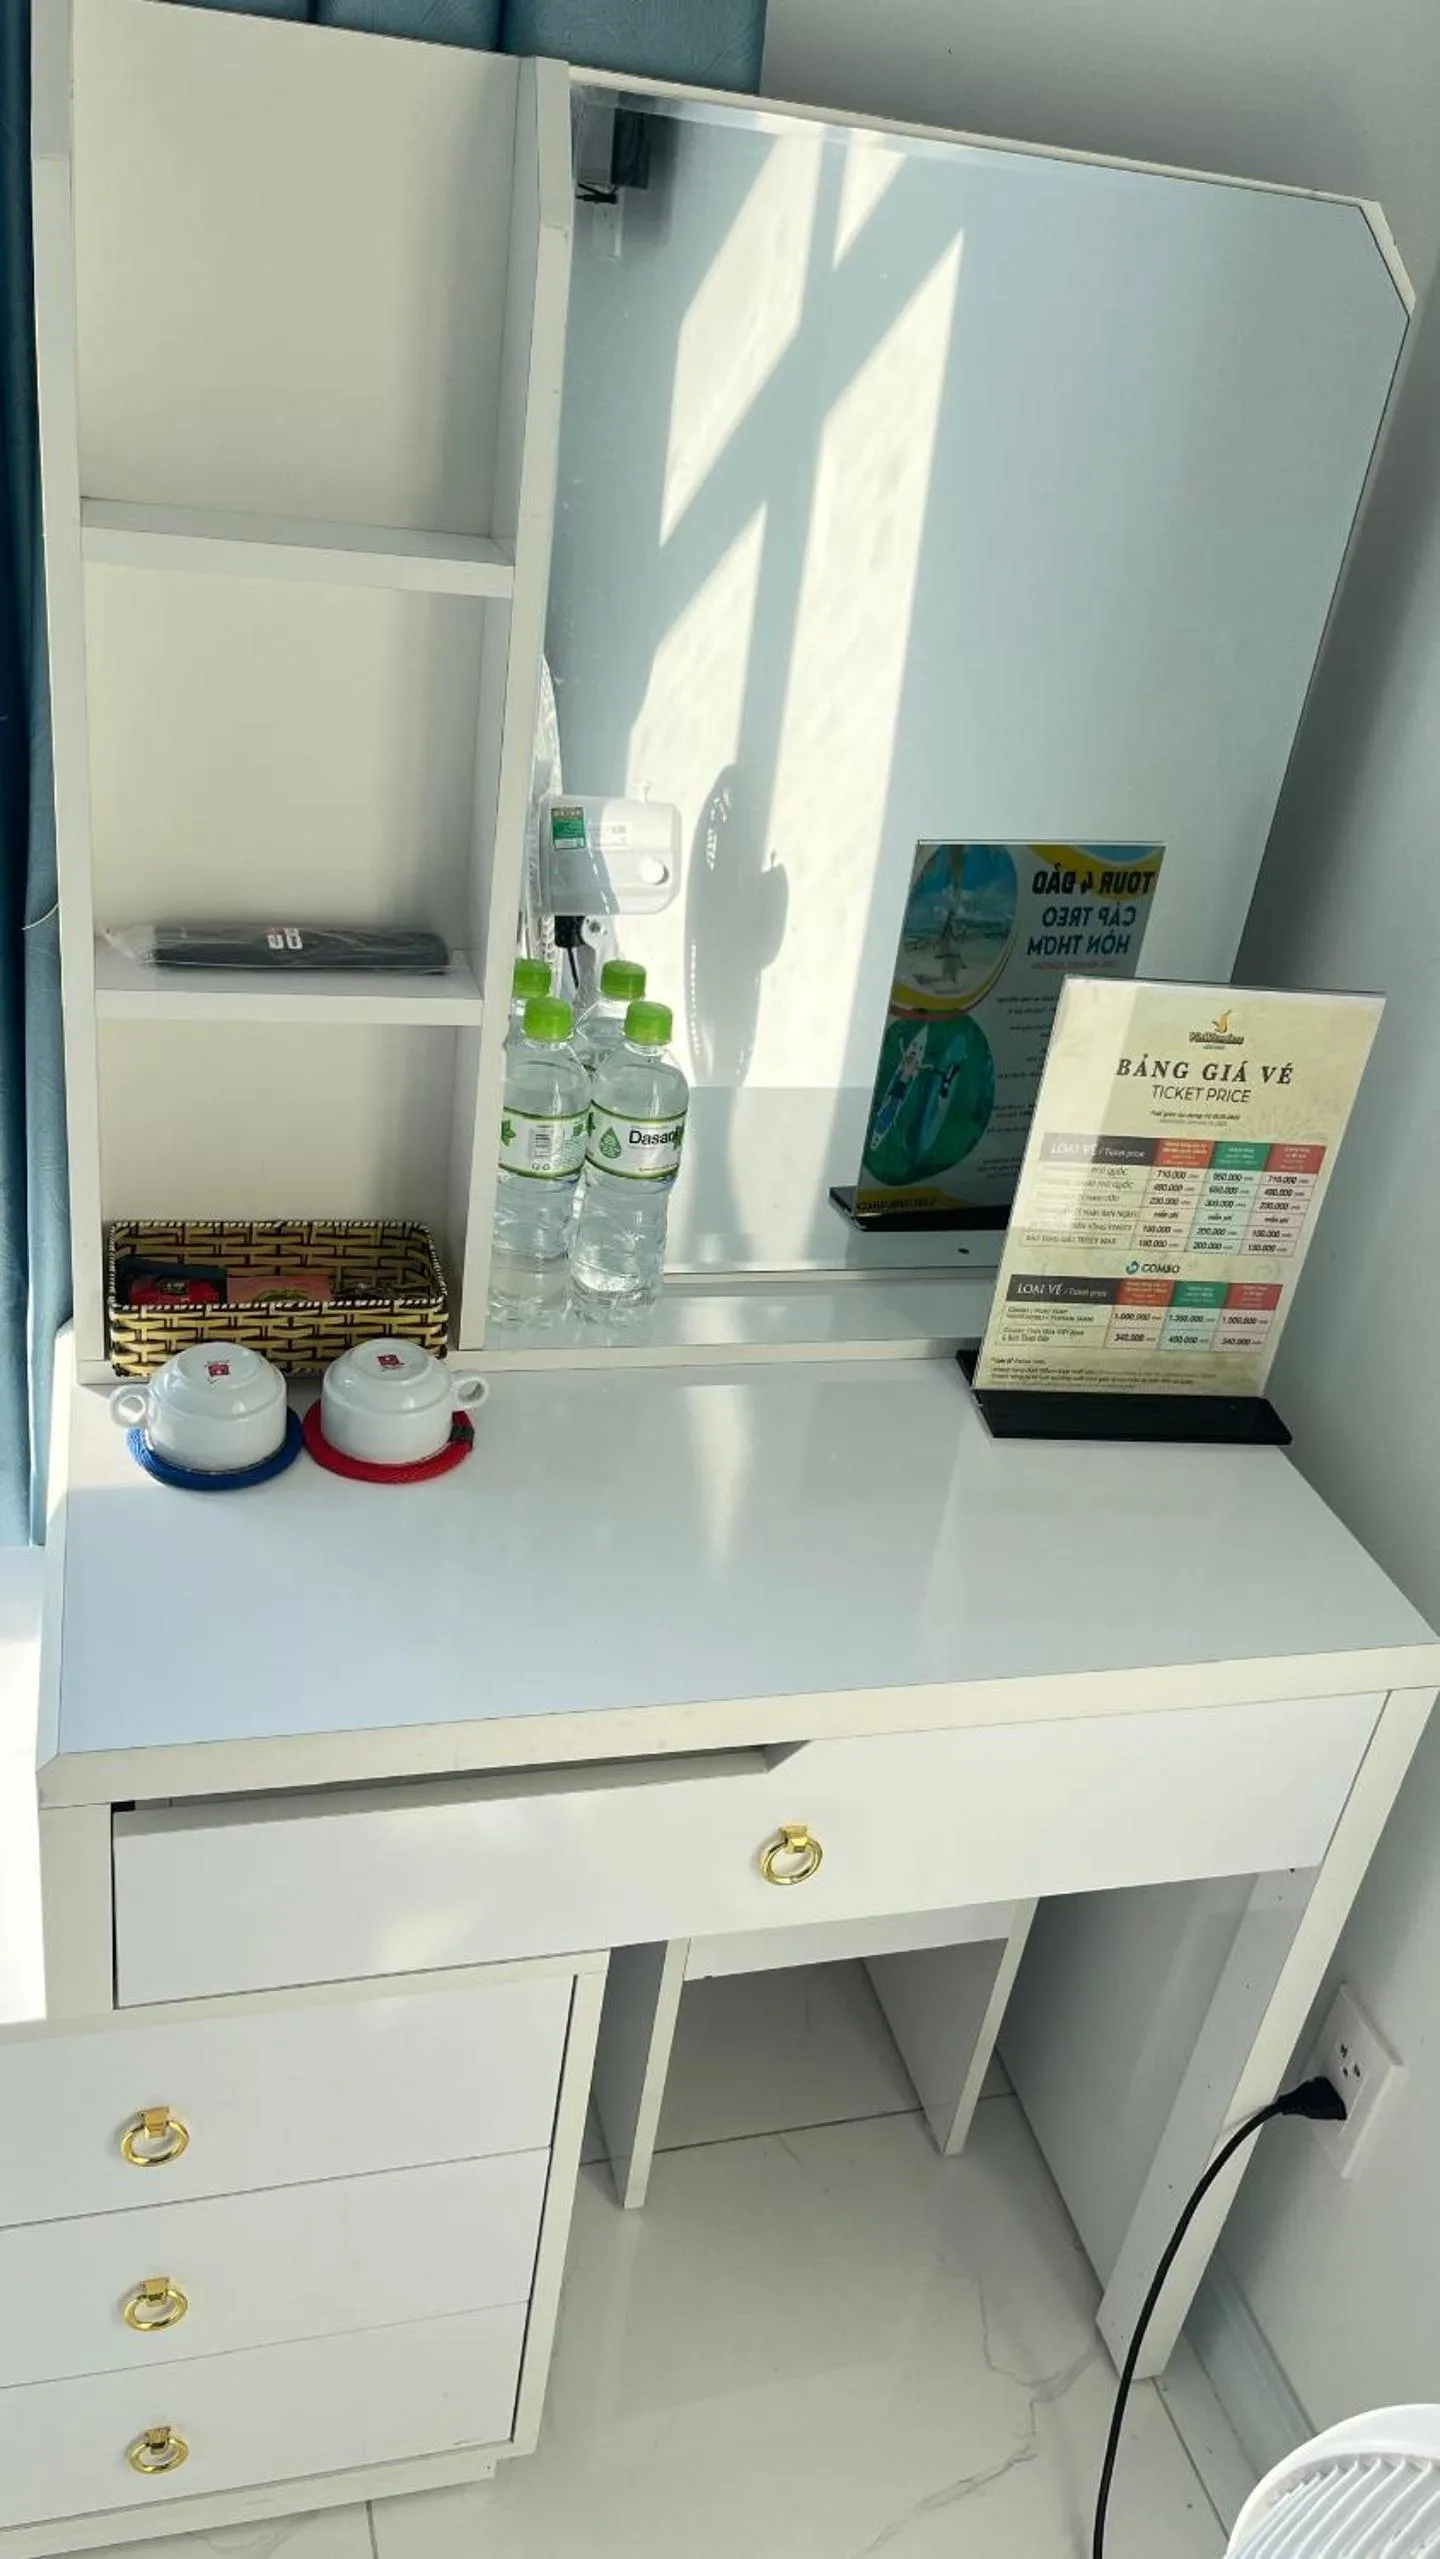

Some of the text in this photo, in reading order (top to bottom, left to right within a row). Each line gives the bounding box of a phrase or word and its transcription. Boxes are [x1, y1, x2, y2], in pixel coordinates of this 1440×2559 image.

[1116, 1053, 1295, 1085] BẢNG GIÁ VÉ
[1151, 1084, 1252, 1104] TICKET PRICE
[1140, 1262, 1181, 1275] COMBO
